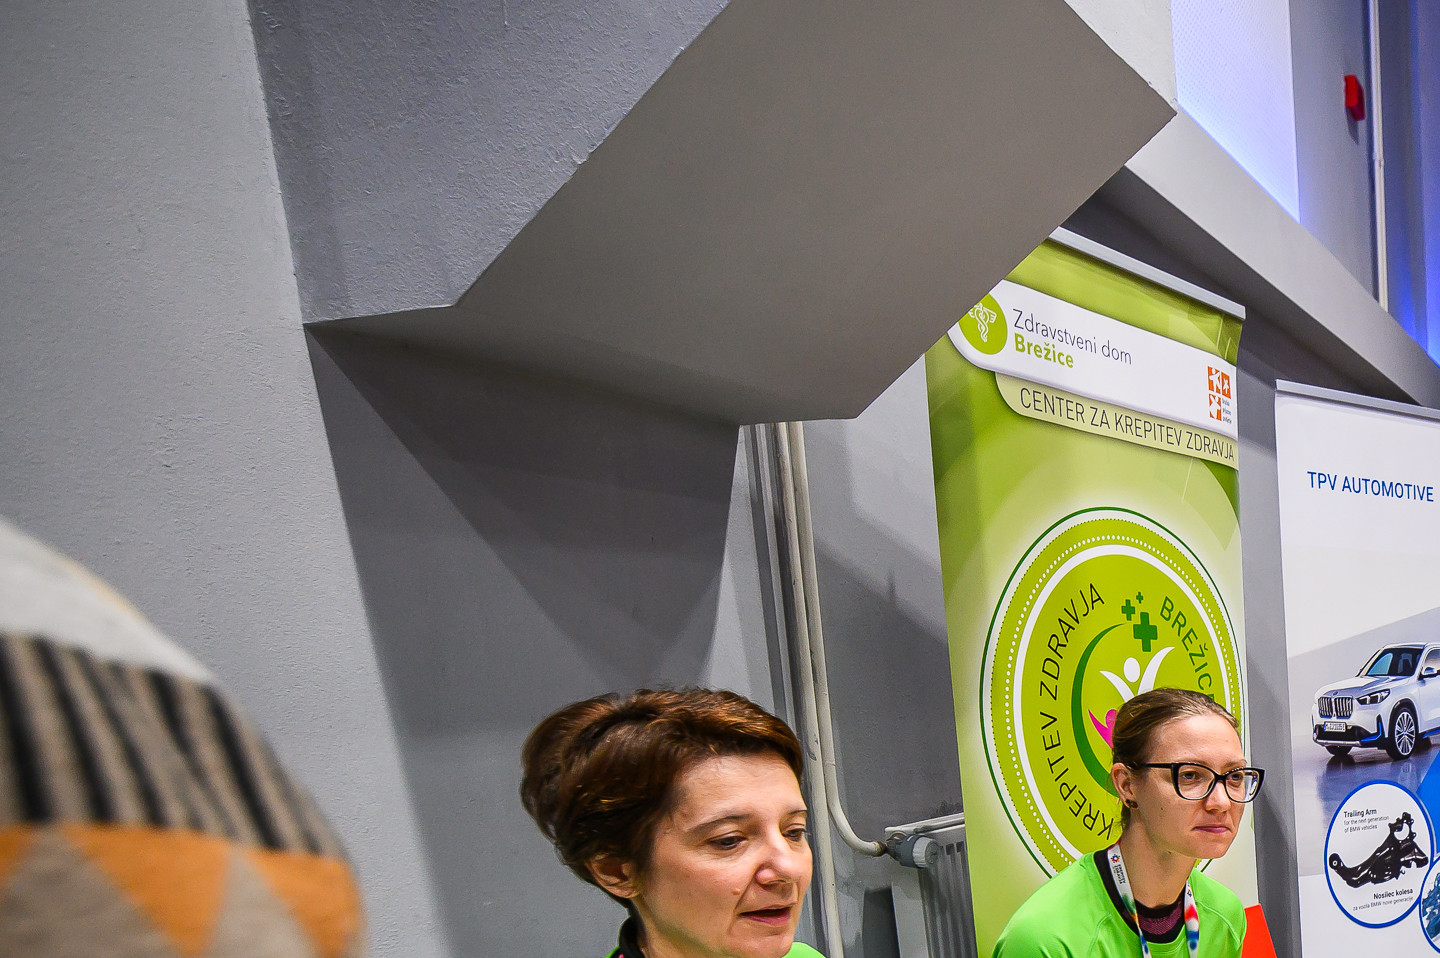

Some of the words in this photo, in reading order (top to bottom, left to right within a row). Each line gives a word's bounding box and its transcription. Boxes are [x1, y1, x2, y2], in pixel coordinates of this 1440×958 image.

[1012, 308, 1097, 354] Zdravstveni
[1101, 343, 1132, 365] dom
[1014, 332, 1074, 369] Brežice
[1020, 387, 1085, 424] CENTER
[1090, 406, 1110, 430] ZA
[1115, 412, 1182, 446] KREPITEV
[1185, 431, 1235, 462] ZDRAVJA
[1306, 470, 1338, 491] TPV
[1341, 475, 1434, 502] AUTOMOTIVE
[1039, 582, 1106, 701] ZDRAVJA
[1039, 712, 1114, 841] KREPITEV
[1344, 810, 1364, 818] Trailing
